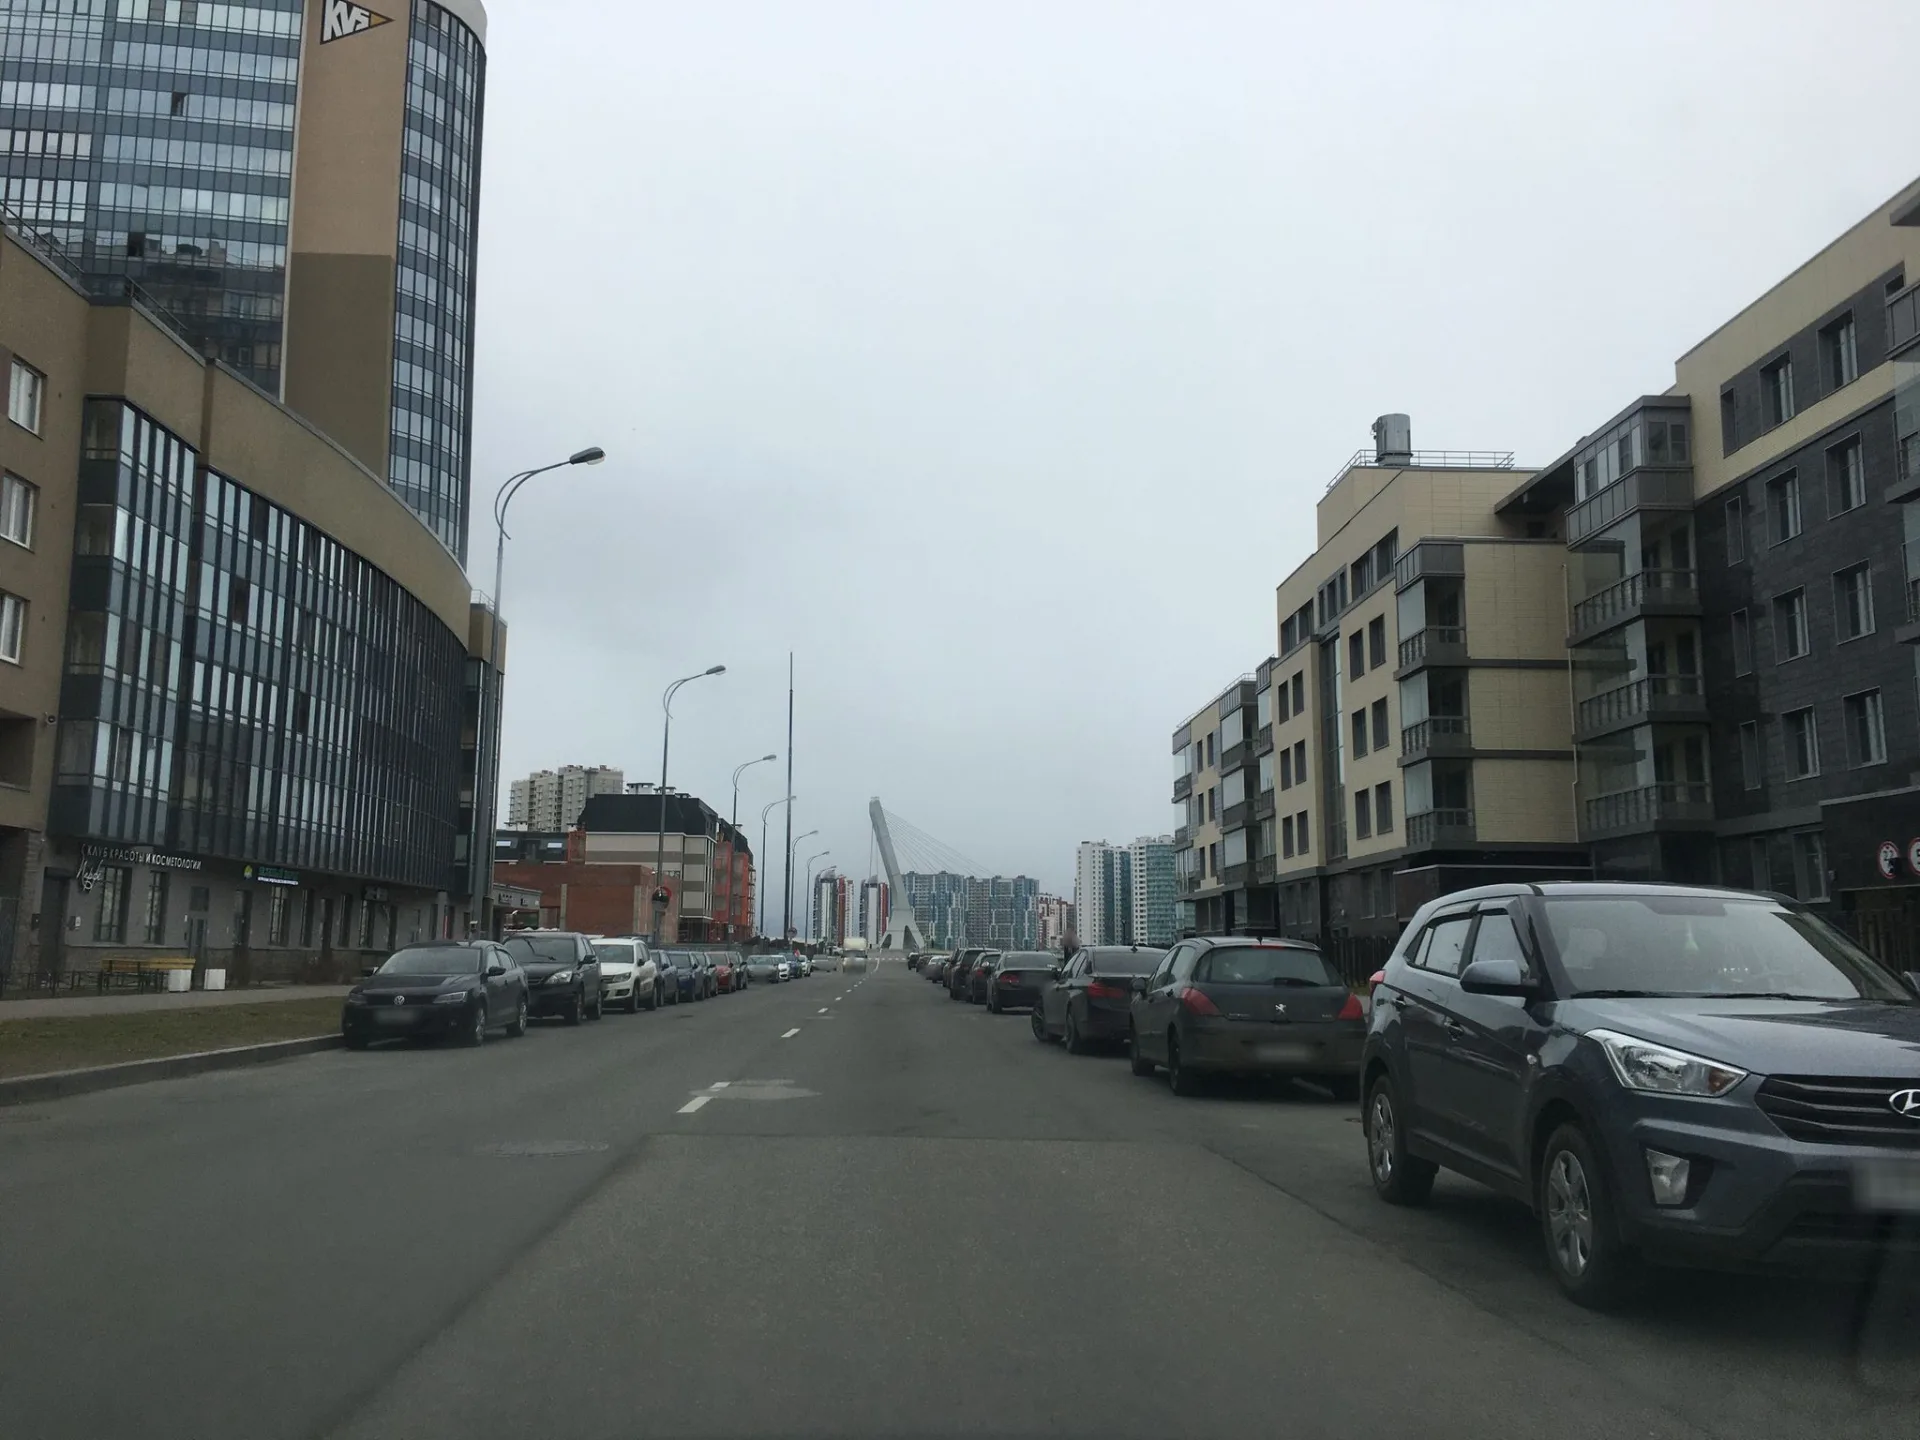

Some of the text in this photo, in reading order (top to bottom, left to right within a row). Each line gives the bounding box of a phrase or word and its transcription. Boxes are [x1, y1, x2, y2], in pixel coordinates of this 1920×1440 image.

[323, 0, 370, 42] KVS
[87, 845, 109, 858] КЛУБ
[109, 847, 144, 862] КРАСОТЫ
[151, 854, 202, 870] КОСМЕТОЛОГИИ
